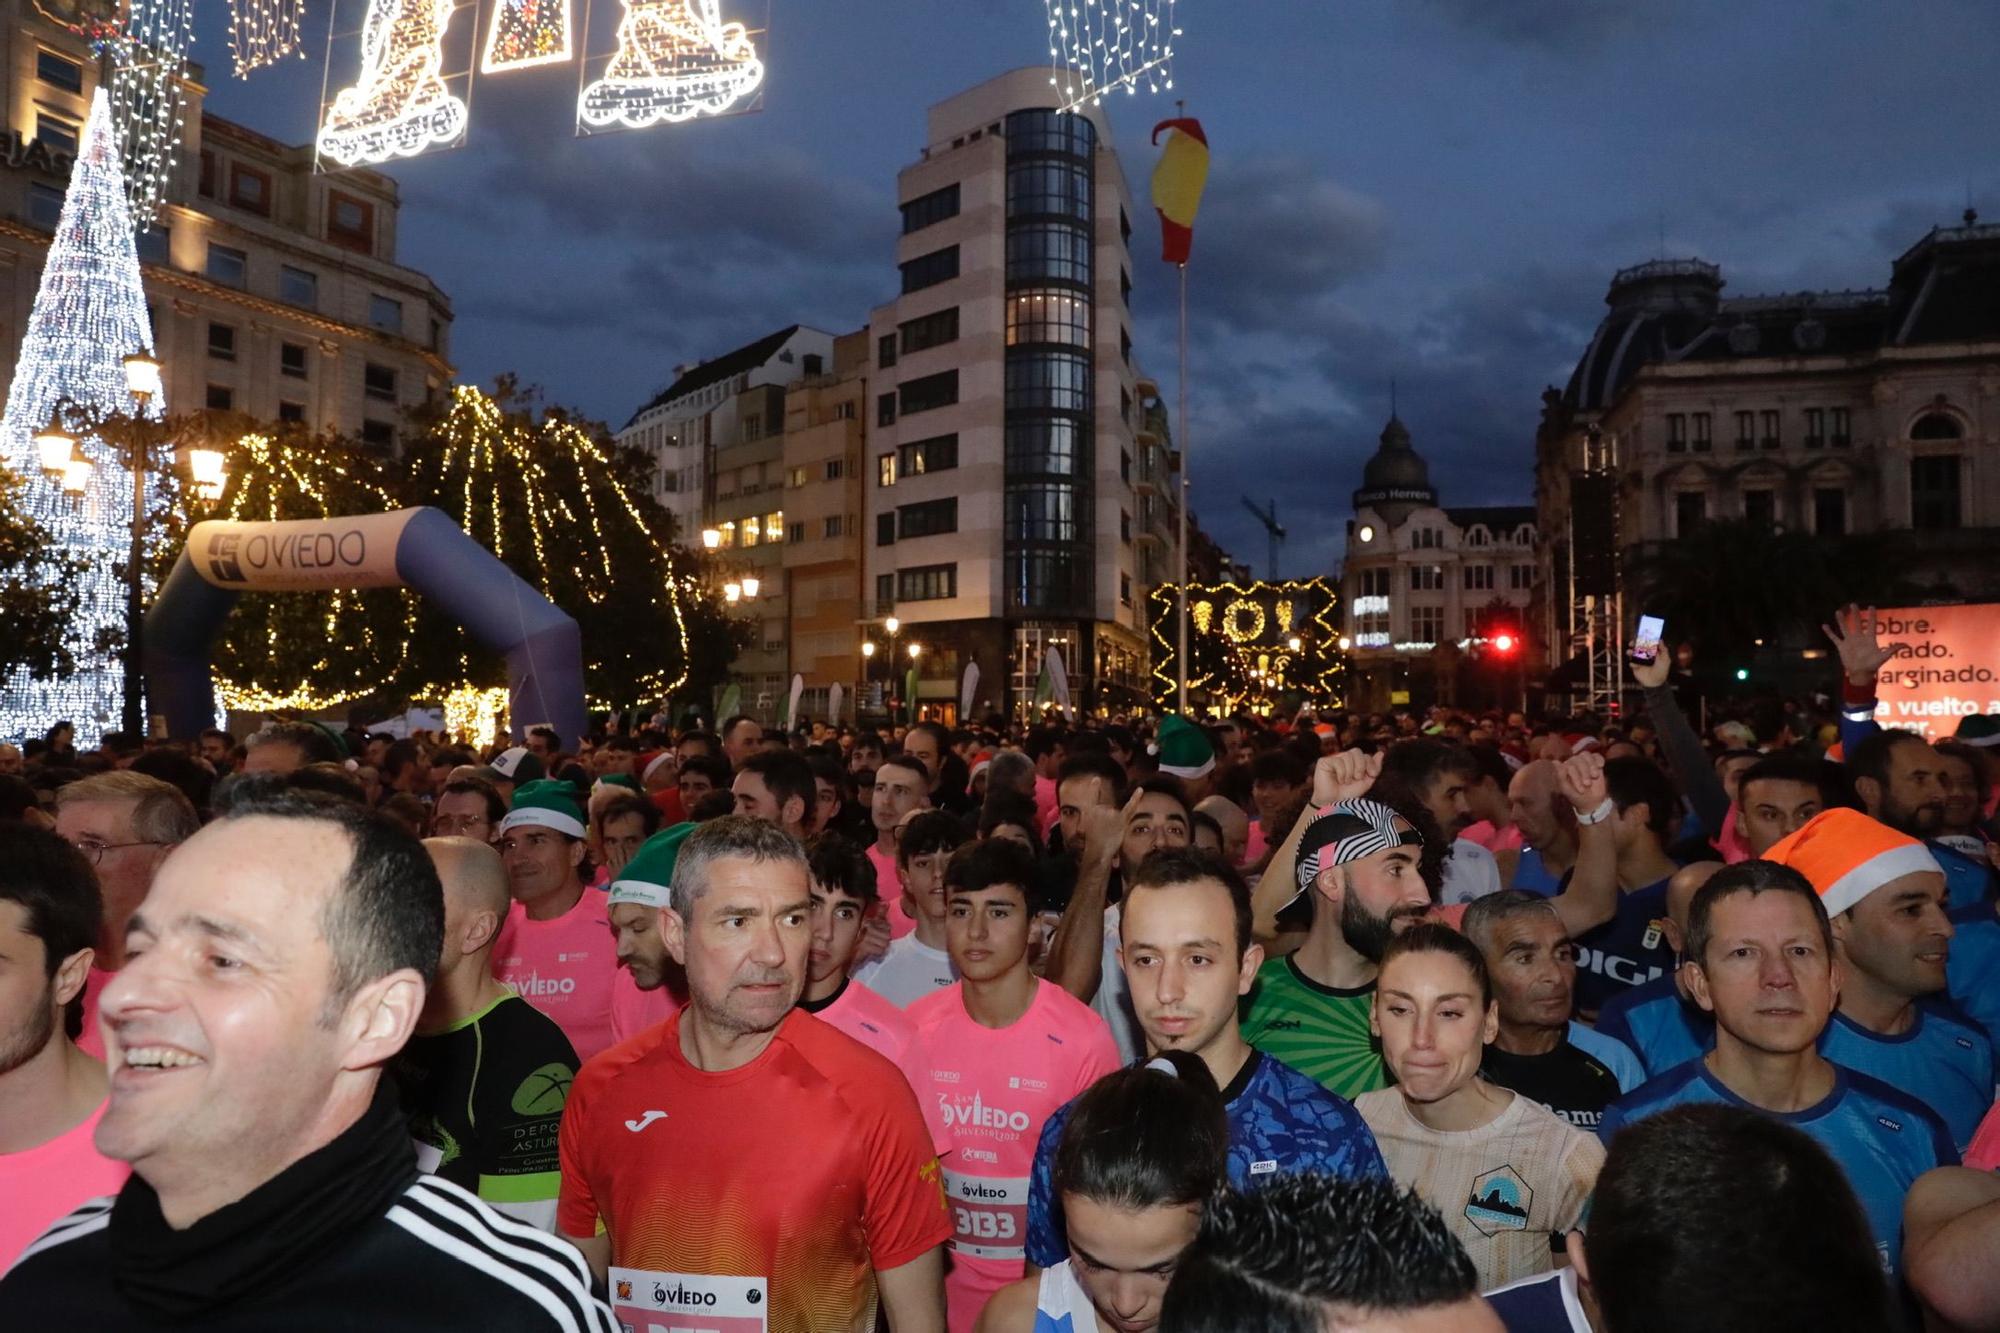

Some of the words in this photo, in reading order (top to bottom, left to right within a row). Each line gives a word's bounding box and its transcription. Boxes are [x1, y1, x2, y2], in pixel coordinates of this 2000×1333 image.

[246, 530, 366, 569] OVIEDO
[1875, 664, 1999, 690] arginado.
[1897, 696, 1980, 716] vuelto
[513, 1136, 559, 1152] ASTUR
[956, 1208, 1016, 1238] 3133
